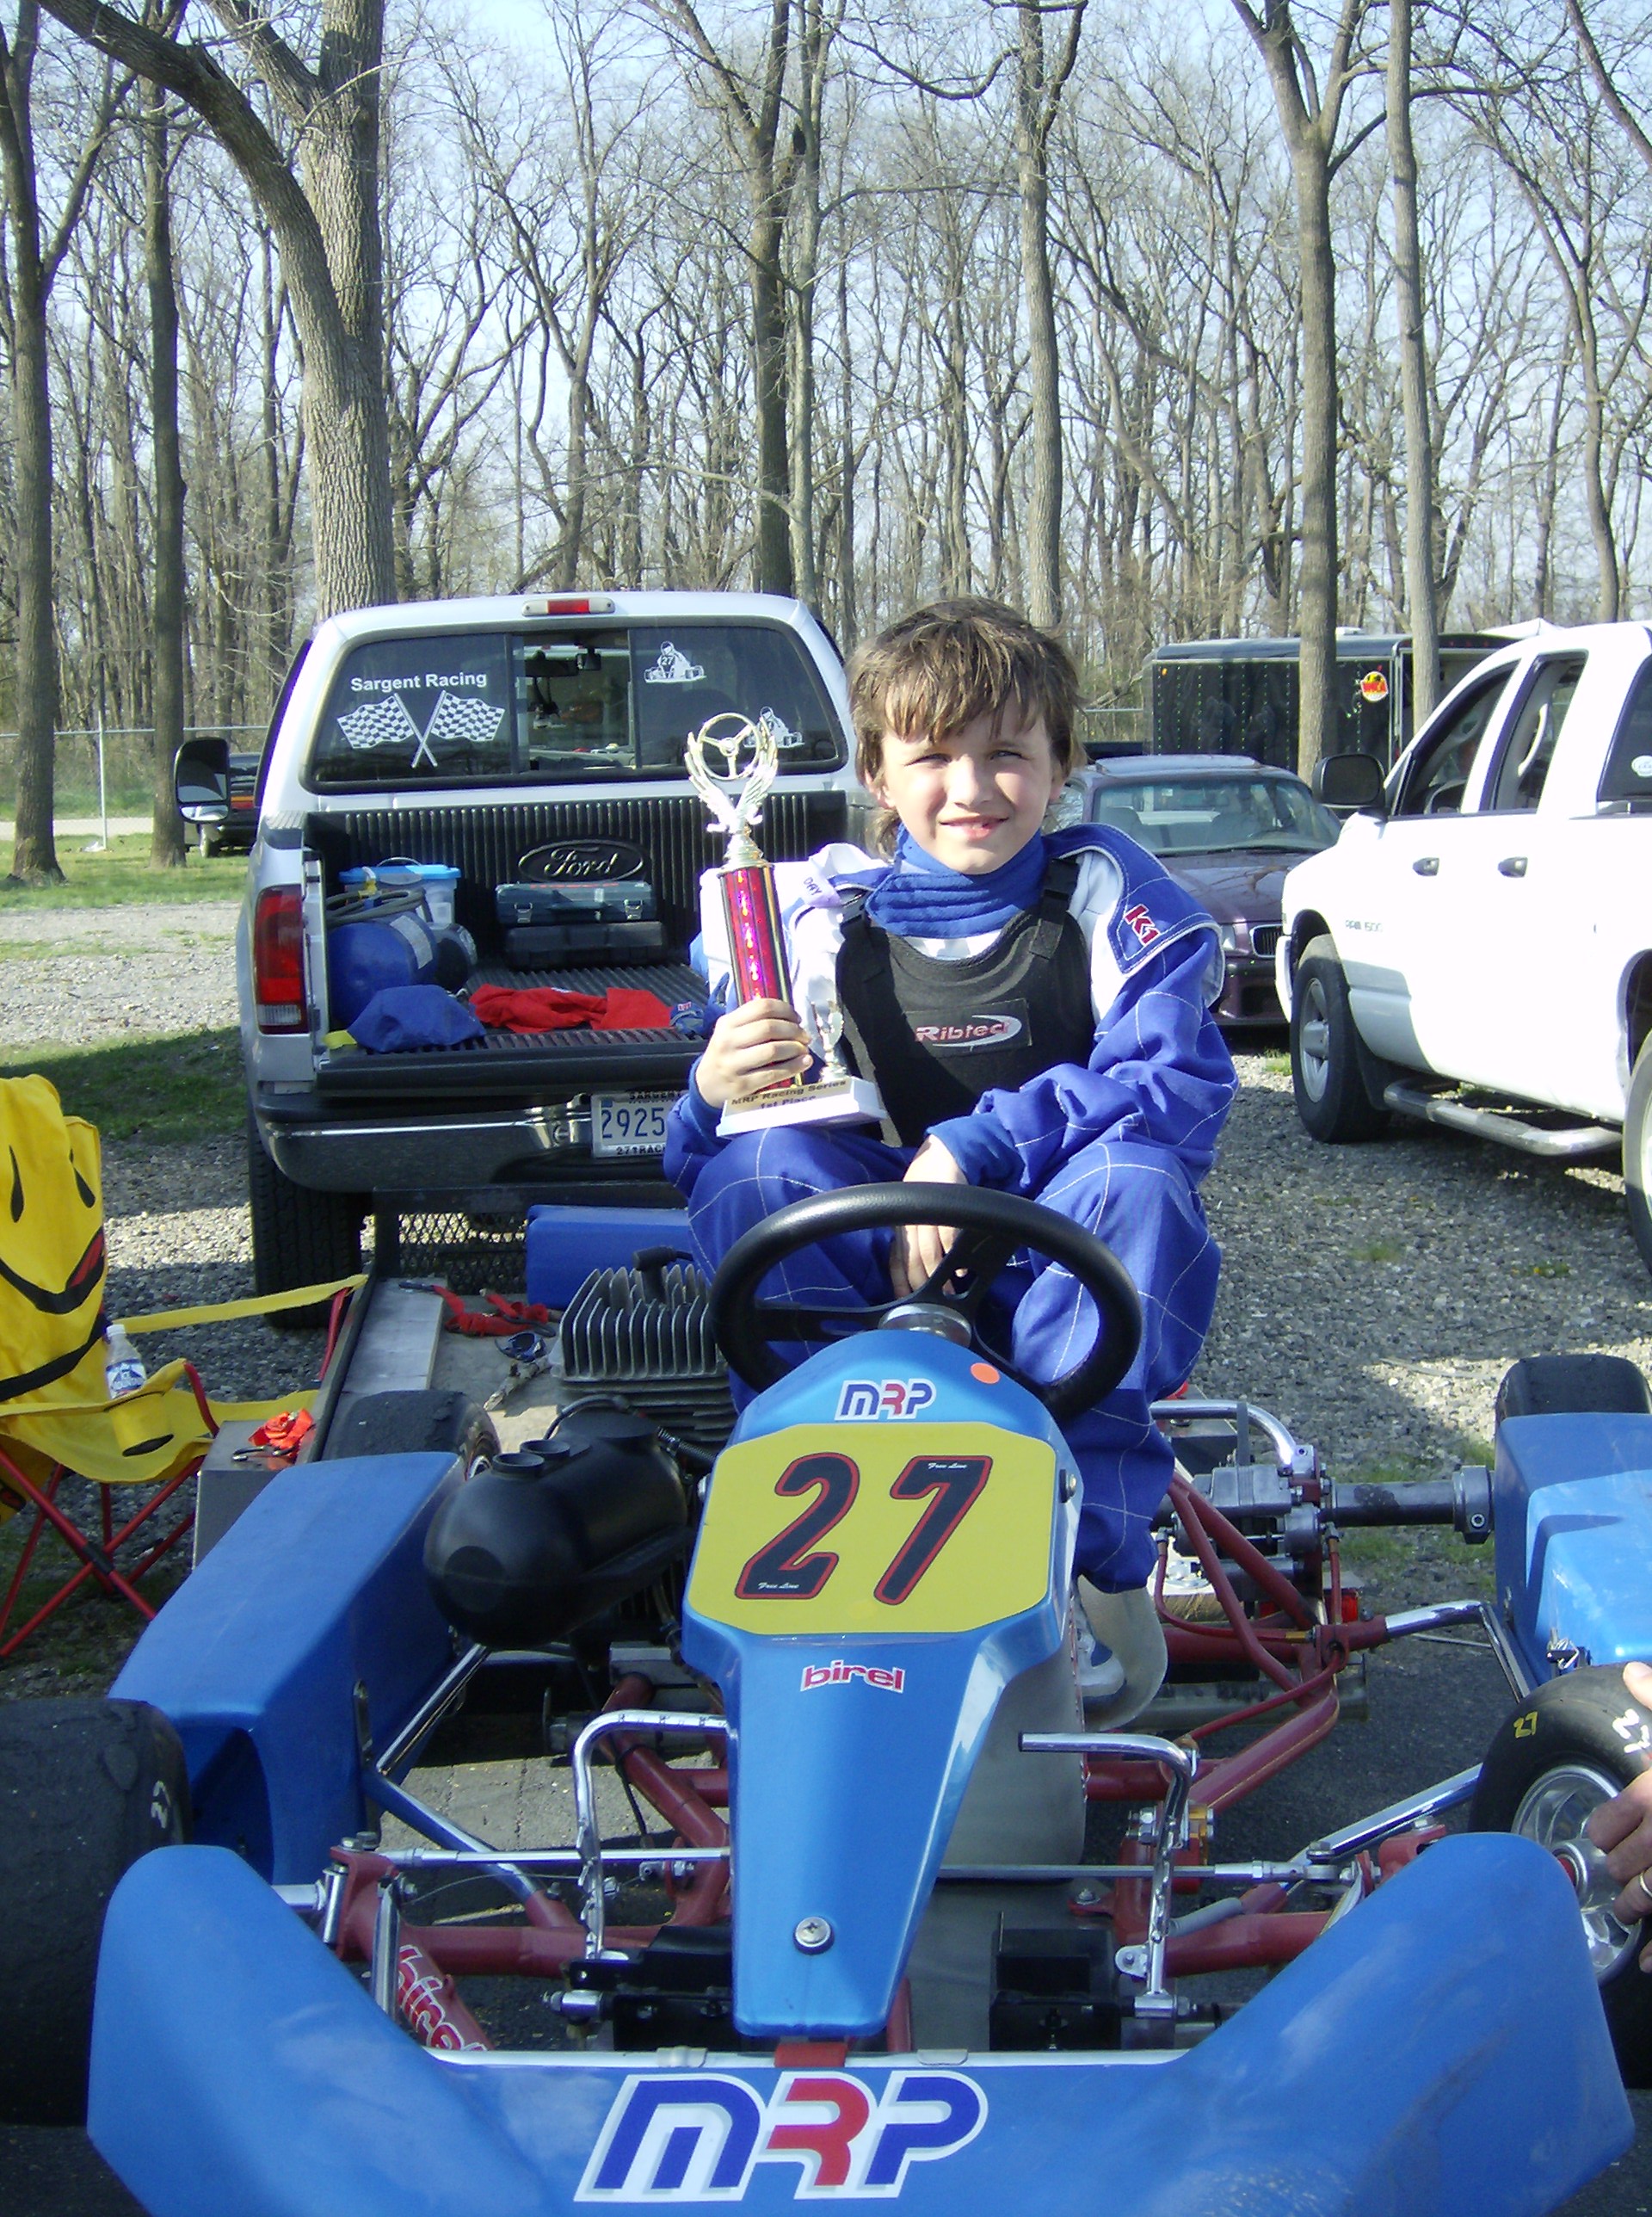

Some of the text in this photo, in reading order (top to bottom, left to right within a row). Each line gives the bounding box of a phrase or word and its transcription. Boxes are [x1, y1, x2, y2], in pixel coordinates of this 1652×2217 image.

[661, 656, 674, 666] 27
[351, 671, 488, 693] Sargent Racing
[544, 846, 619, 877] Ford
[1124, 904, 1162, 947] K1
[731, 1079, 847, 1105] MRP Racing Series
[781, 1095, 817, 1106] Place
[601, 1108, 665, 1139] 2925
[835, 1378, 937, 1420] MRP
[735, 1452, 993, 1606] 27
[800, 1658, 905, 1694] birel
[1513, 1711, 1538, 1738] 27
[398, 1944, 488, 2051] bire
[574, 2070, 989, 2203] MRP
